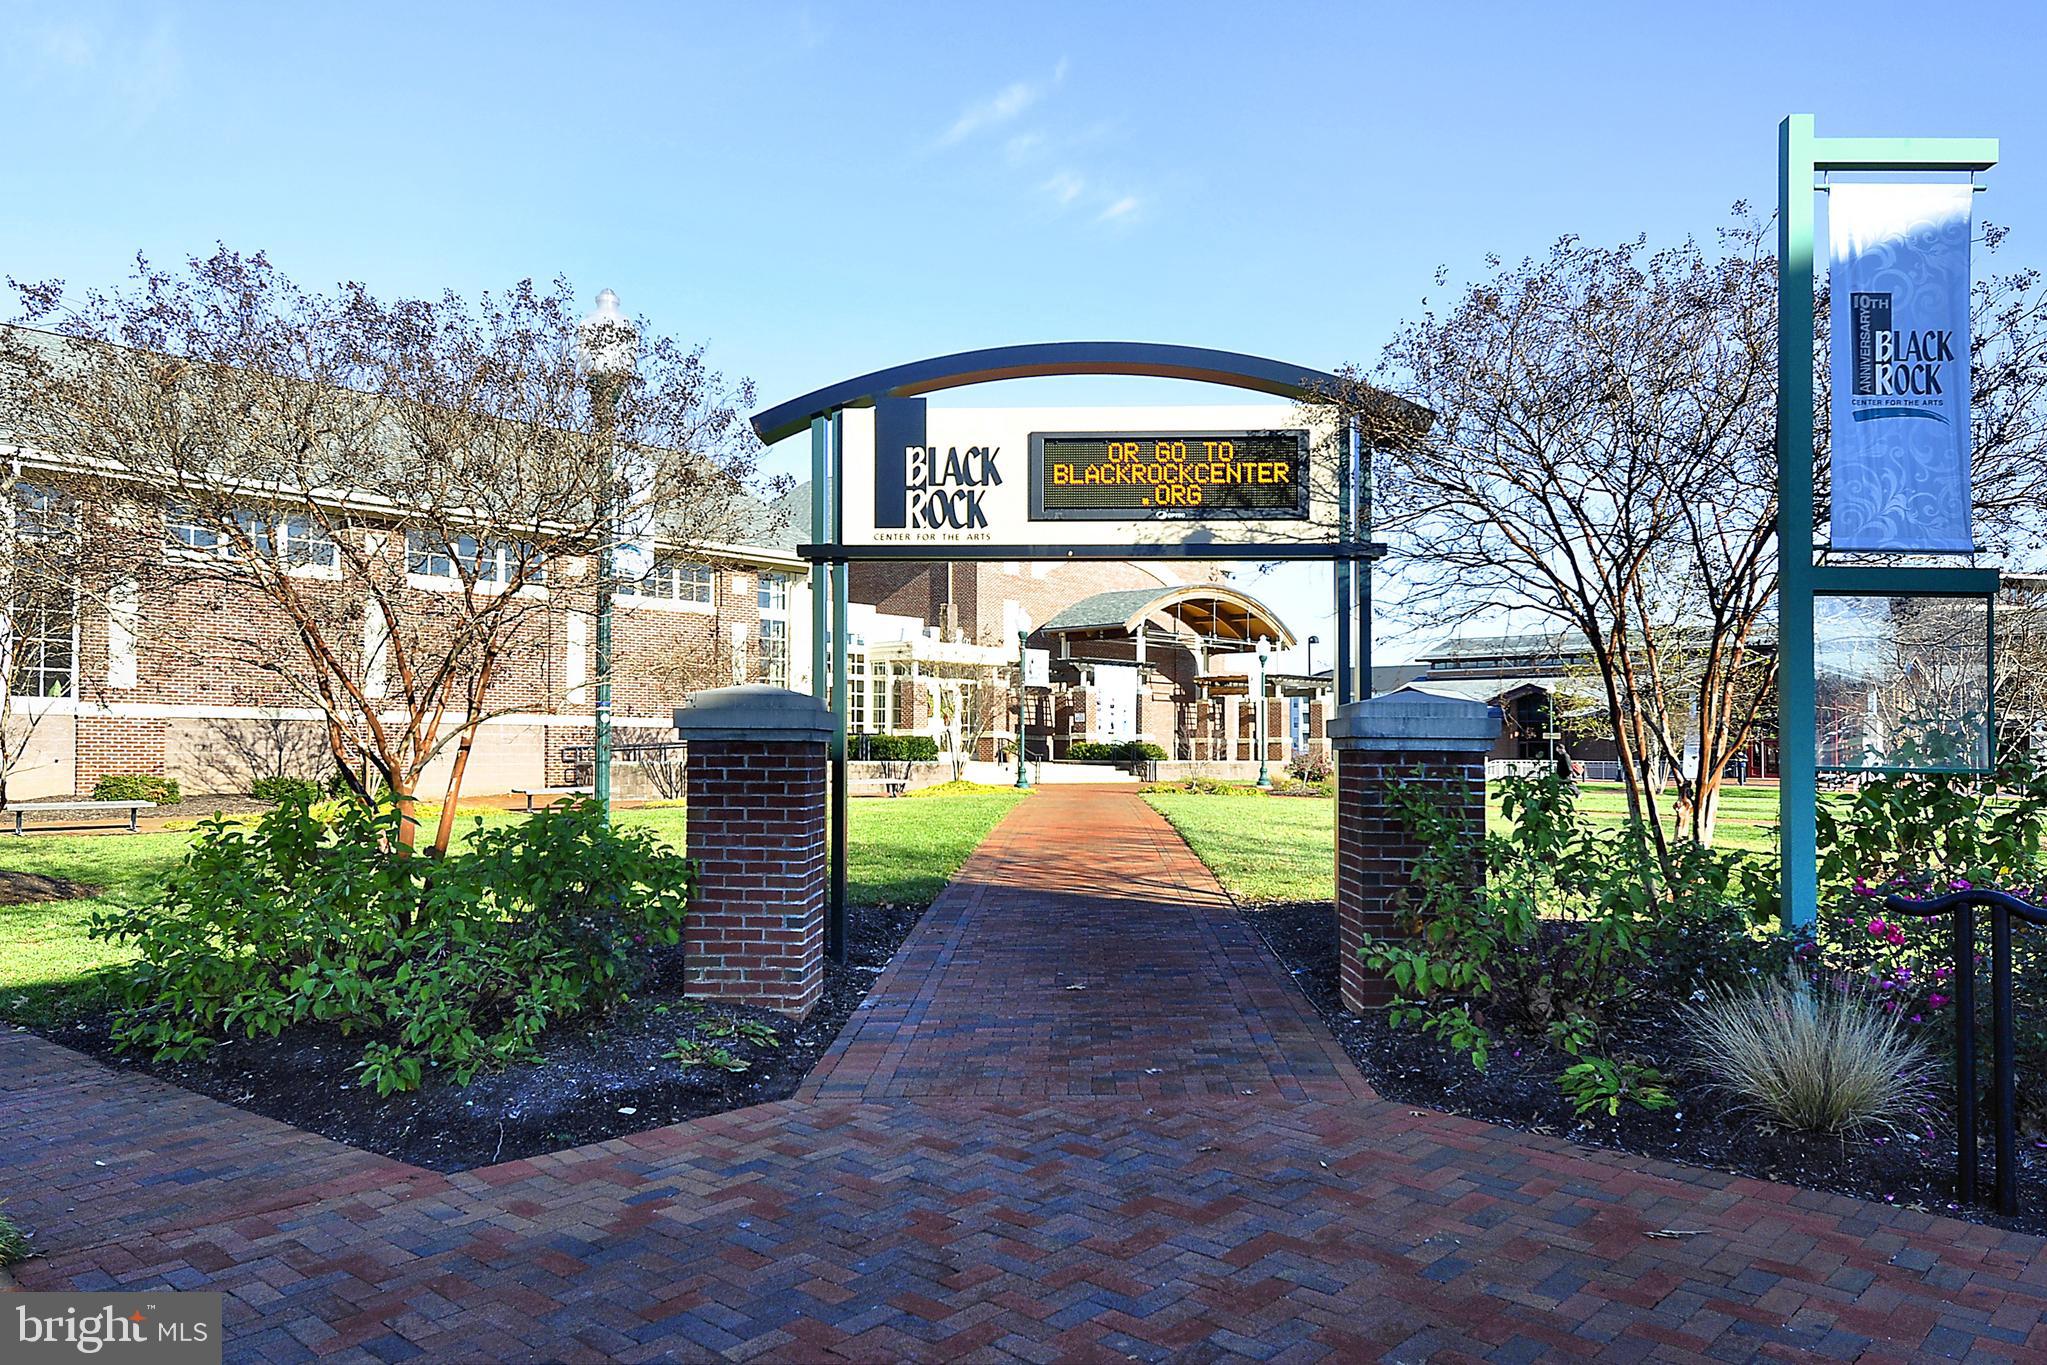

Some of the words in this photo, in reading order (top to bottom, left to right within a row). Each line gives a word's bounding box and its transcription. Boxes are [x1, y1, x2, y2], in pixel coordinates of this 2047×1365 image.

[1853, 295, 1889, 309] 10TH
[1860, 308, 1871, 392] ANNIVERSARY
[1875, 330, 1954, 362] BLACK
[1875, 363, 1942, 395] ROCK
[1107, 441, 1139, 463] OR
[1154, 441, 1187, 463] GO
[1202, 441, 1234, 463] TO
[905, 446, 1003, 487] BLACK
[1053, 462, 1291, 485] BLACKROCKCENTER
[905, 488, 988, 529] ROCK
[1141, 483, 1203, 507] .ORG
[873, 533, 911, 541] CENTER
[916, 533, 936, 541] FOR
[942, 533, 960, 541] THE
[966, 533, 991, 541] ARTS
